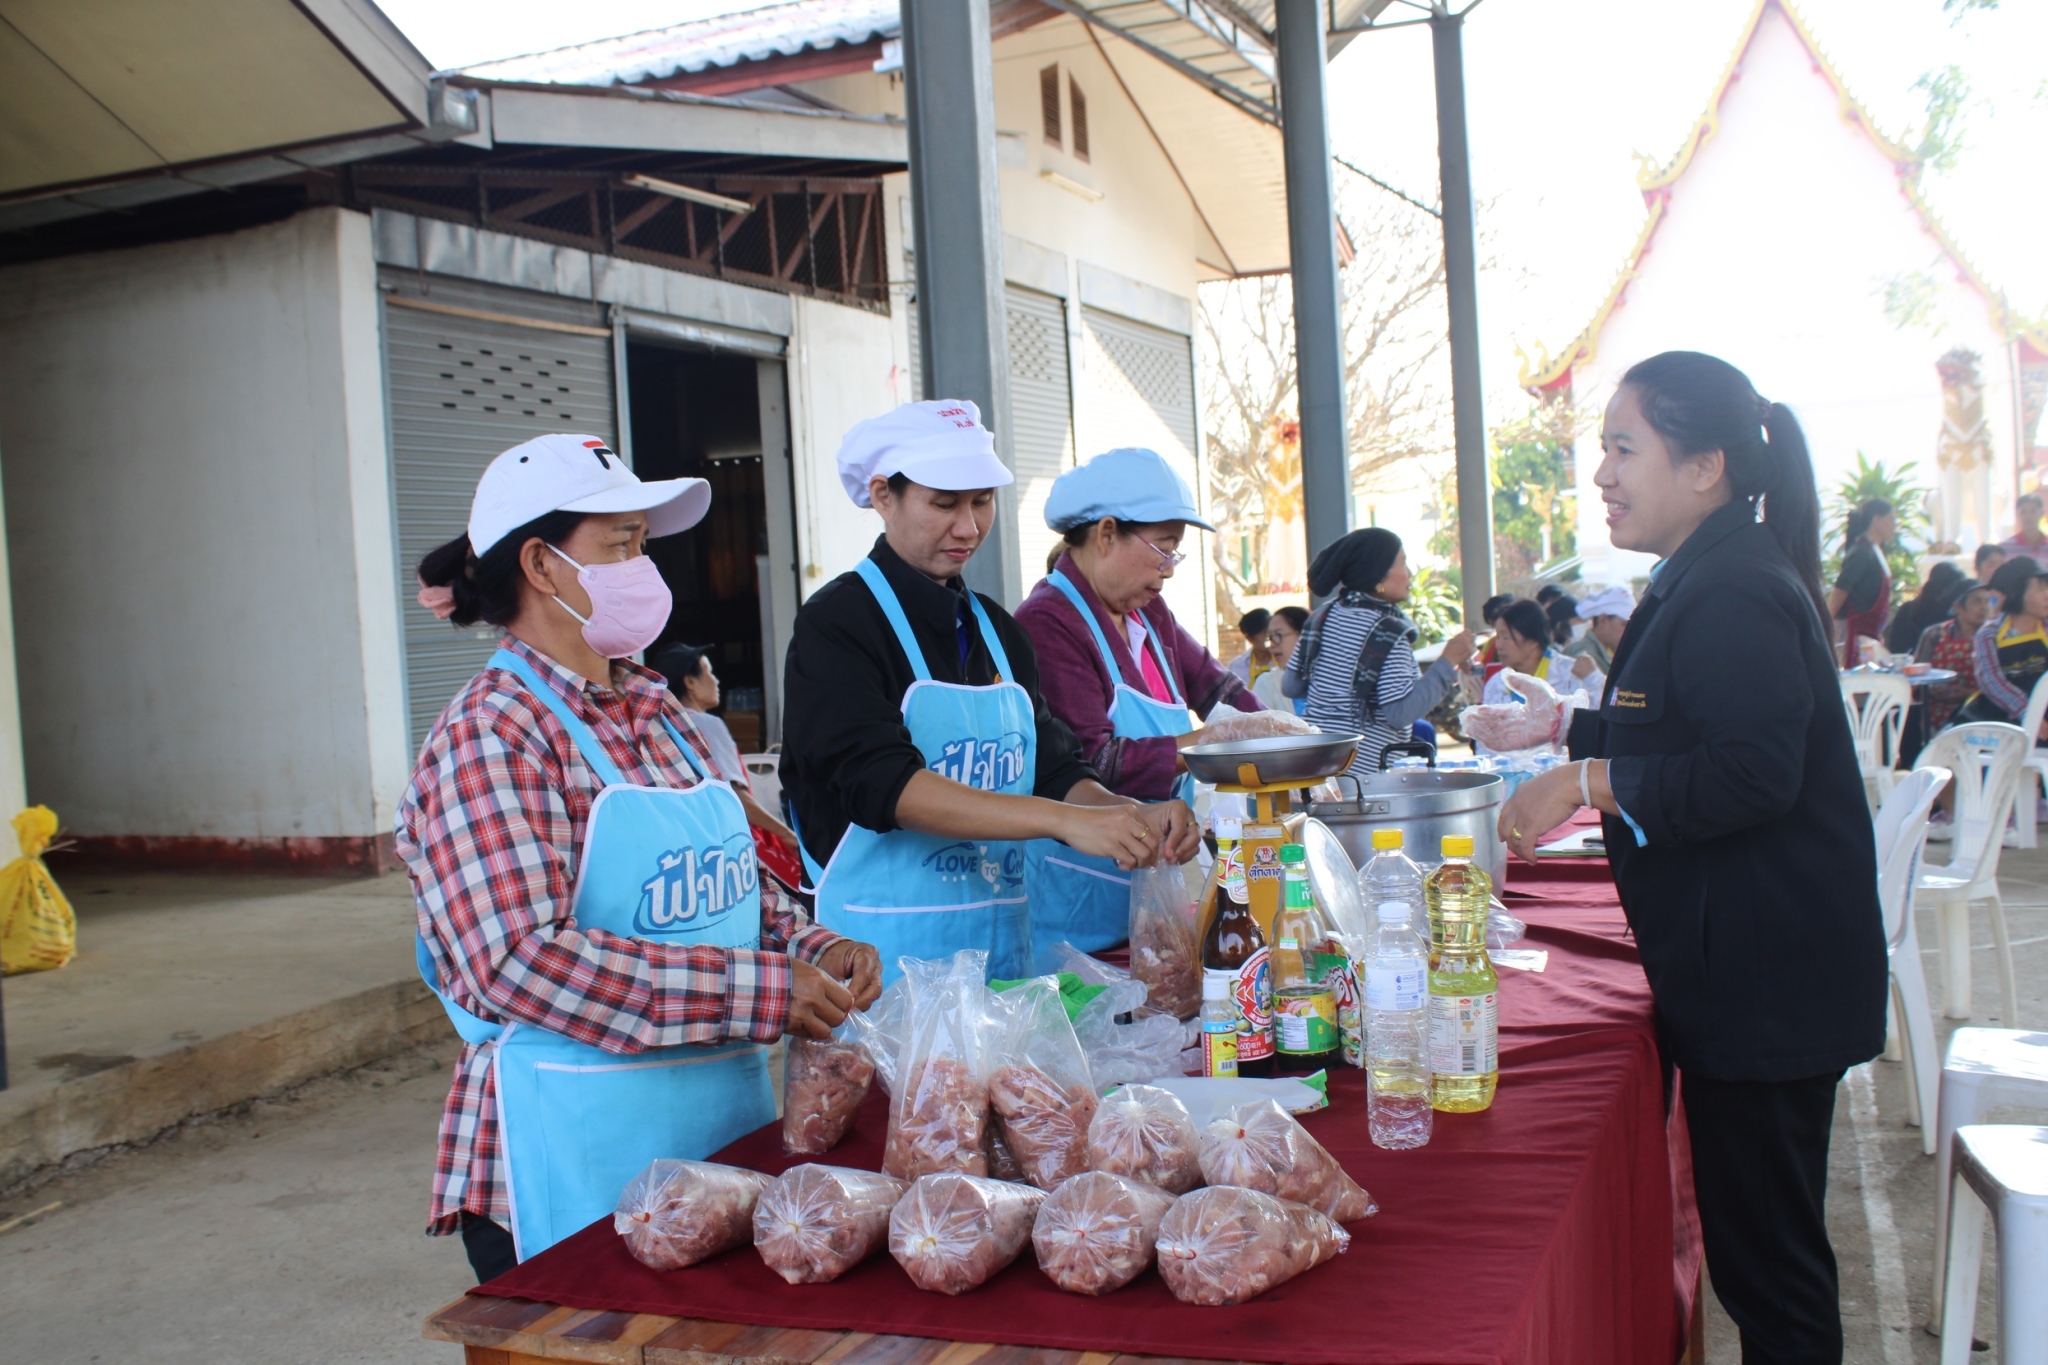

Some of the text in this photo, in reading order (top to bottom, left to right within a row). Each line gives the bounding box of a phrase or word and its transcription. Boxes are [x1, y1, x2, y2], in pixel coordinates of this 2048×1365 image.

[930, 738, 1026, 791] ฟ้าไทย
[642, 845, 757, 927] ฟ้าไทย
[935, 855, 978, 873] LOVE
[985, 867, 997, 877] TO
